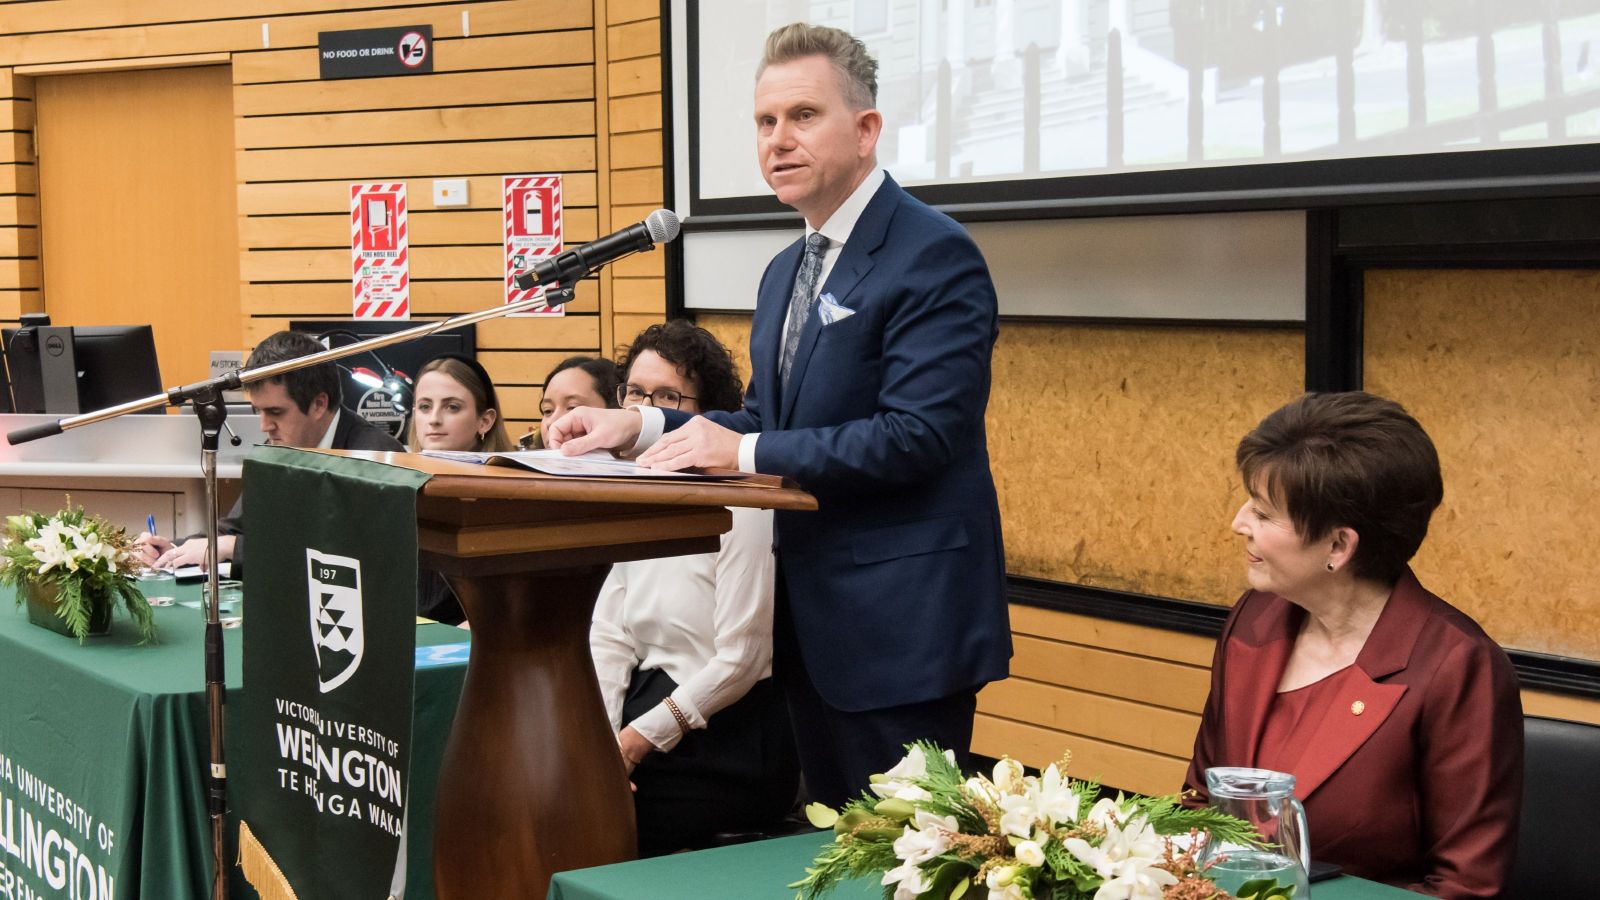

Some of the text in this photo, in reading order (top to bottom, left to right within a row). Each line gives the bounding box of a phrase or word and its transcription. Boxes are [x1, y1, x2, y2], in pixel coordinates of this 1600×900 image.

[323, 47, 394, 59] NO FOOD OR DRINK
[381, 400, 392, 408] Ree
[320, 568, 337, 580] 197
[318, 719, 386, 752] NIVERSITY
[388, 740, 399, 758] OF
[276, 722, 402, 807] WELNGTON
[17, 764, 92, 840] UNIVERSITY
[98, 822, 114, 856] OF
[278, 768, 402, 837] TE HENGA WAKA
